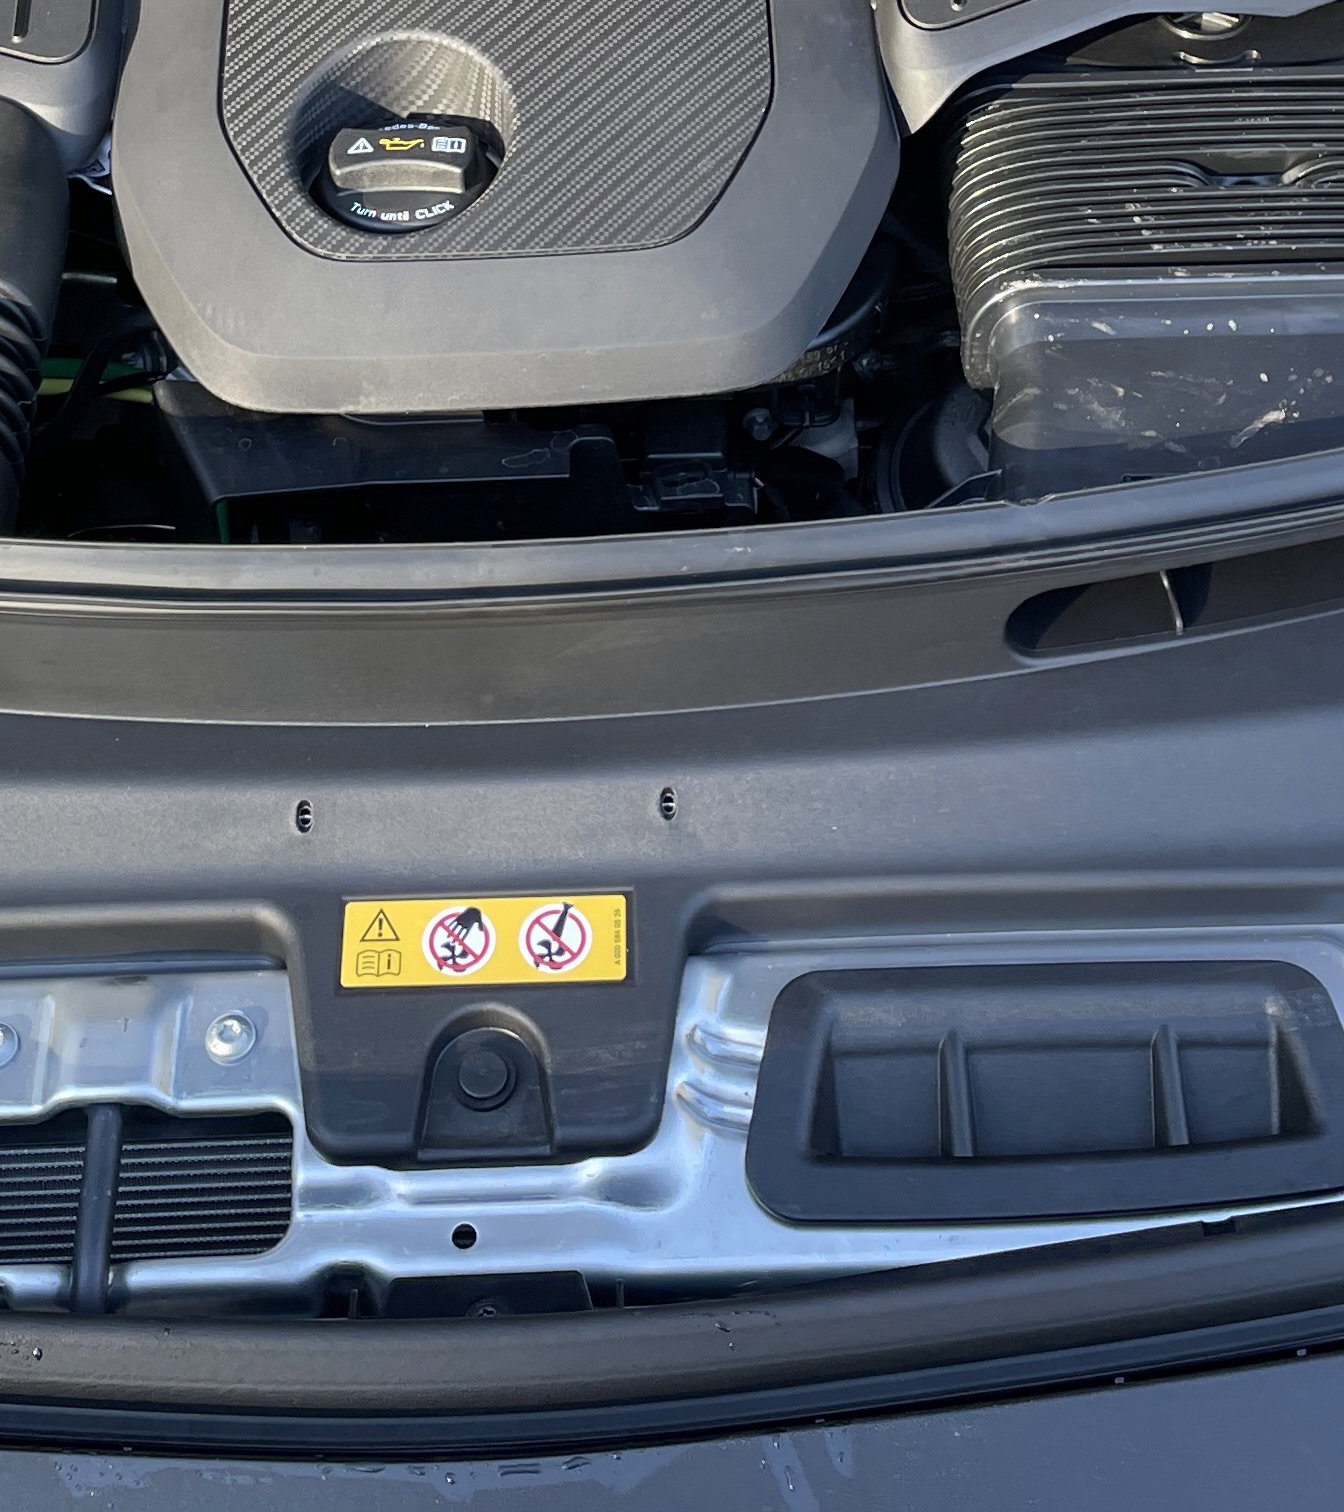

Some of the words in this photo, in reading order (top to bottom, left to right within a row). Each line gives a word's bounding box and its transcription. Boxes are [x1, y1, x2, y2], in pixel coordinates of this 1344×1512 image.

[351, 201, 377, 219] Turn
[380, 210, 410, 221] until
[414, 199, 455, 220] CLICK
